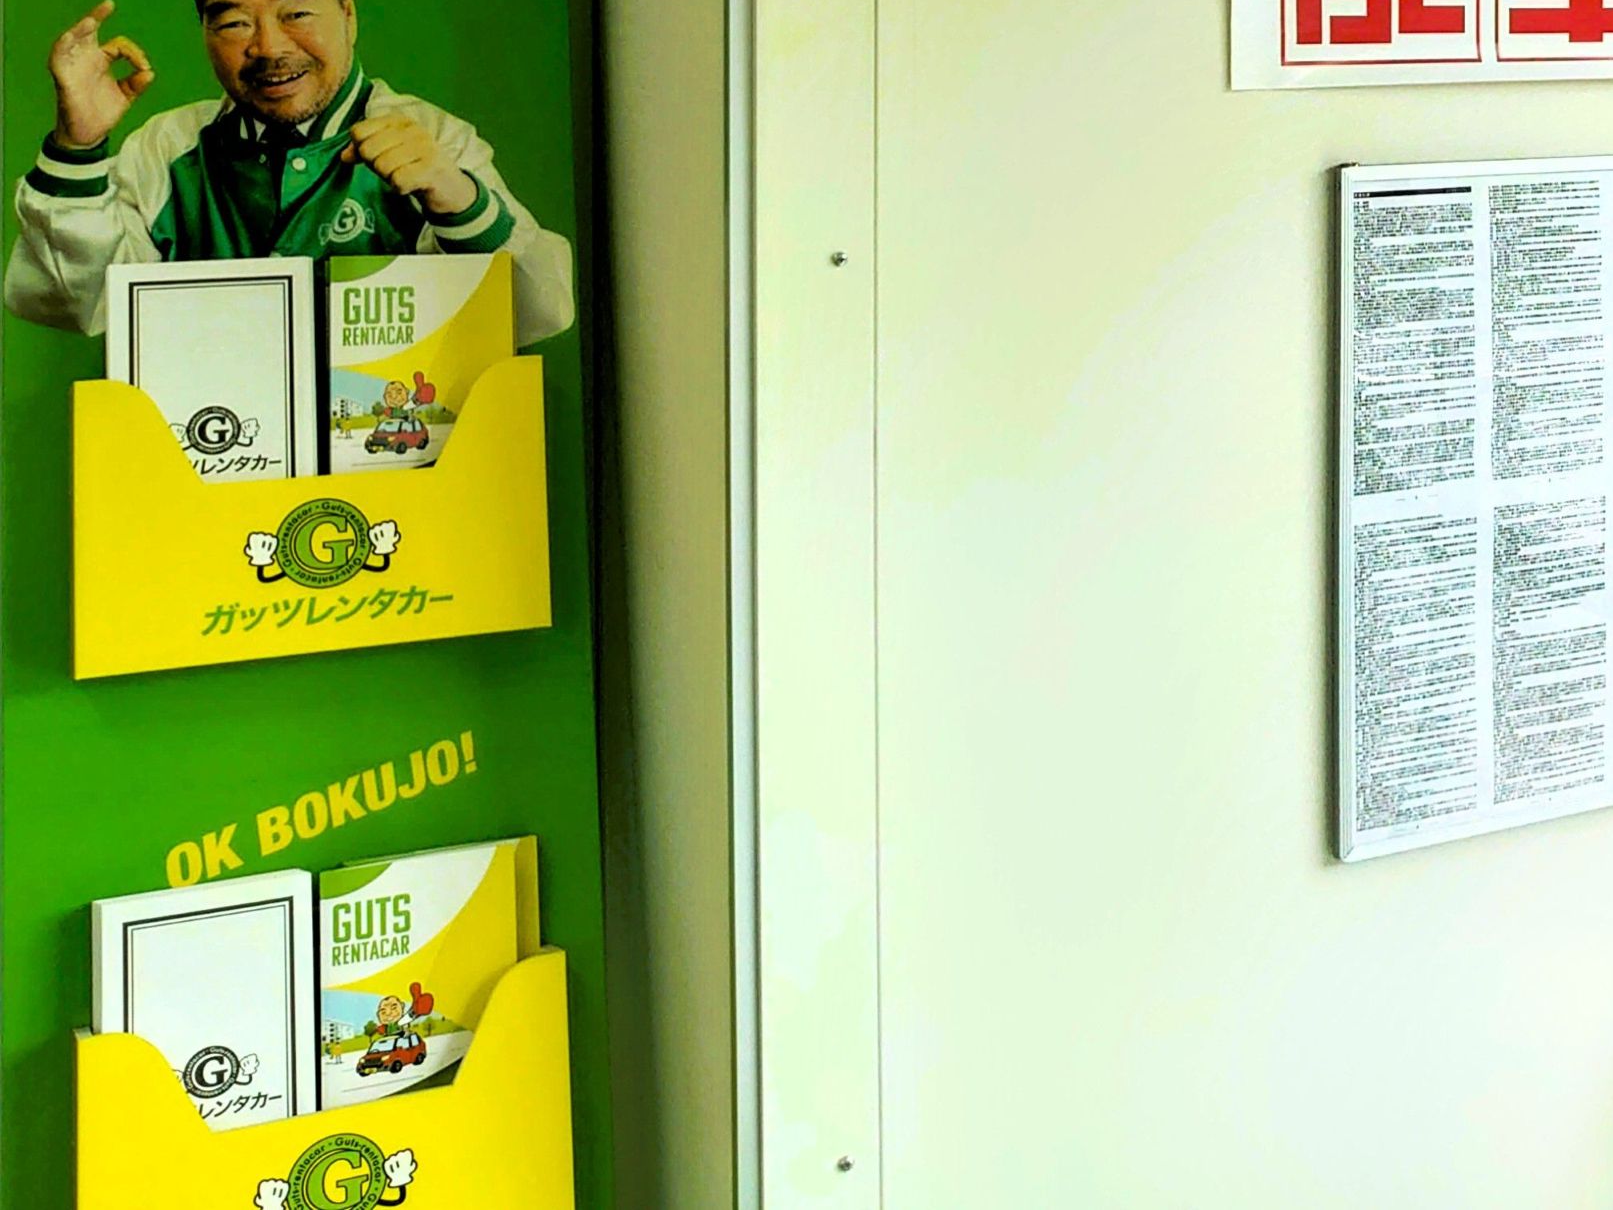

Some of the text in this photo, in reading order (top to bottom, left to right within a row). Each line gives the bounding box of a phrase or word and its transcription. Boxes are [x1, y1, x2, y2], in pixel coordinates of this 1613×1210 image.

[343, 286, 415, 325] GUTS
[342, 324, 414, 347] RENTACAR
[200, 585, 454, 637] ガッツレンタカー
[165, 731, 478, 889] OK BOKUJO!
[332, 893, 411, 944] GUTS
[332, 934, 410, 967] RENTACAR
